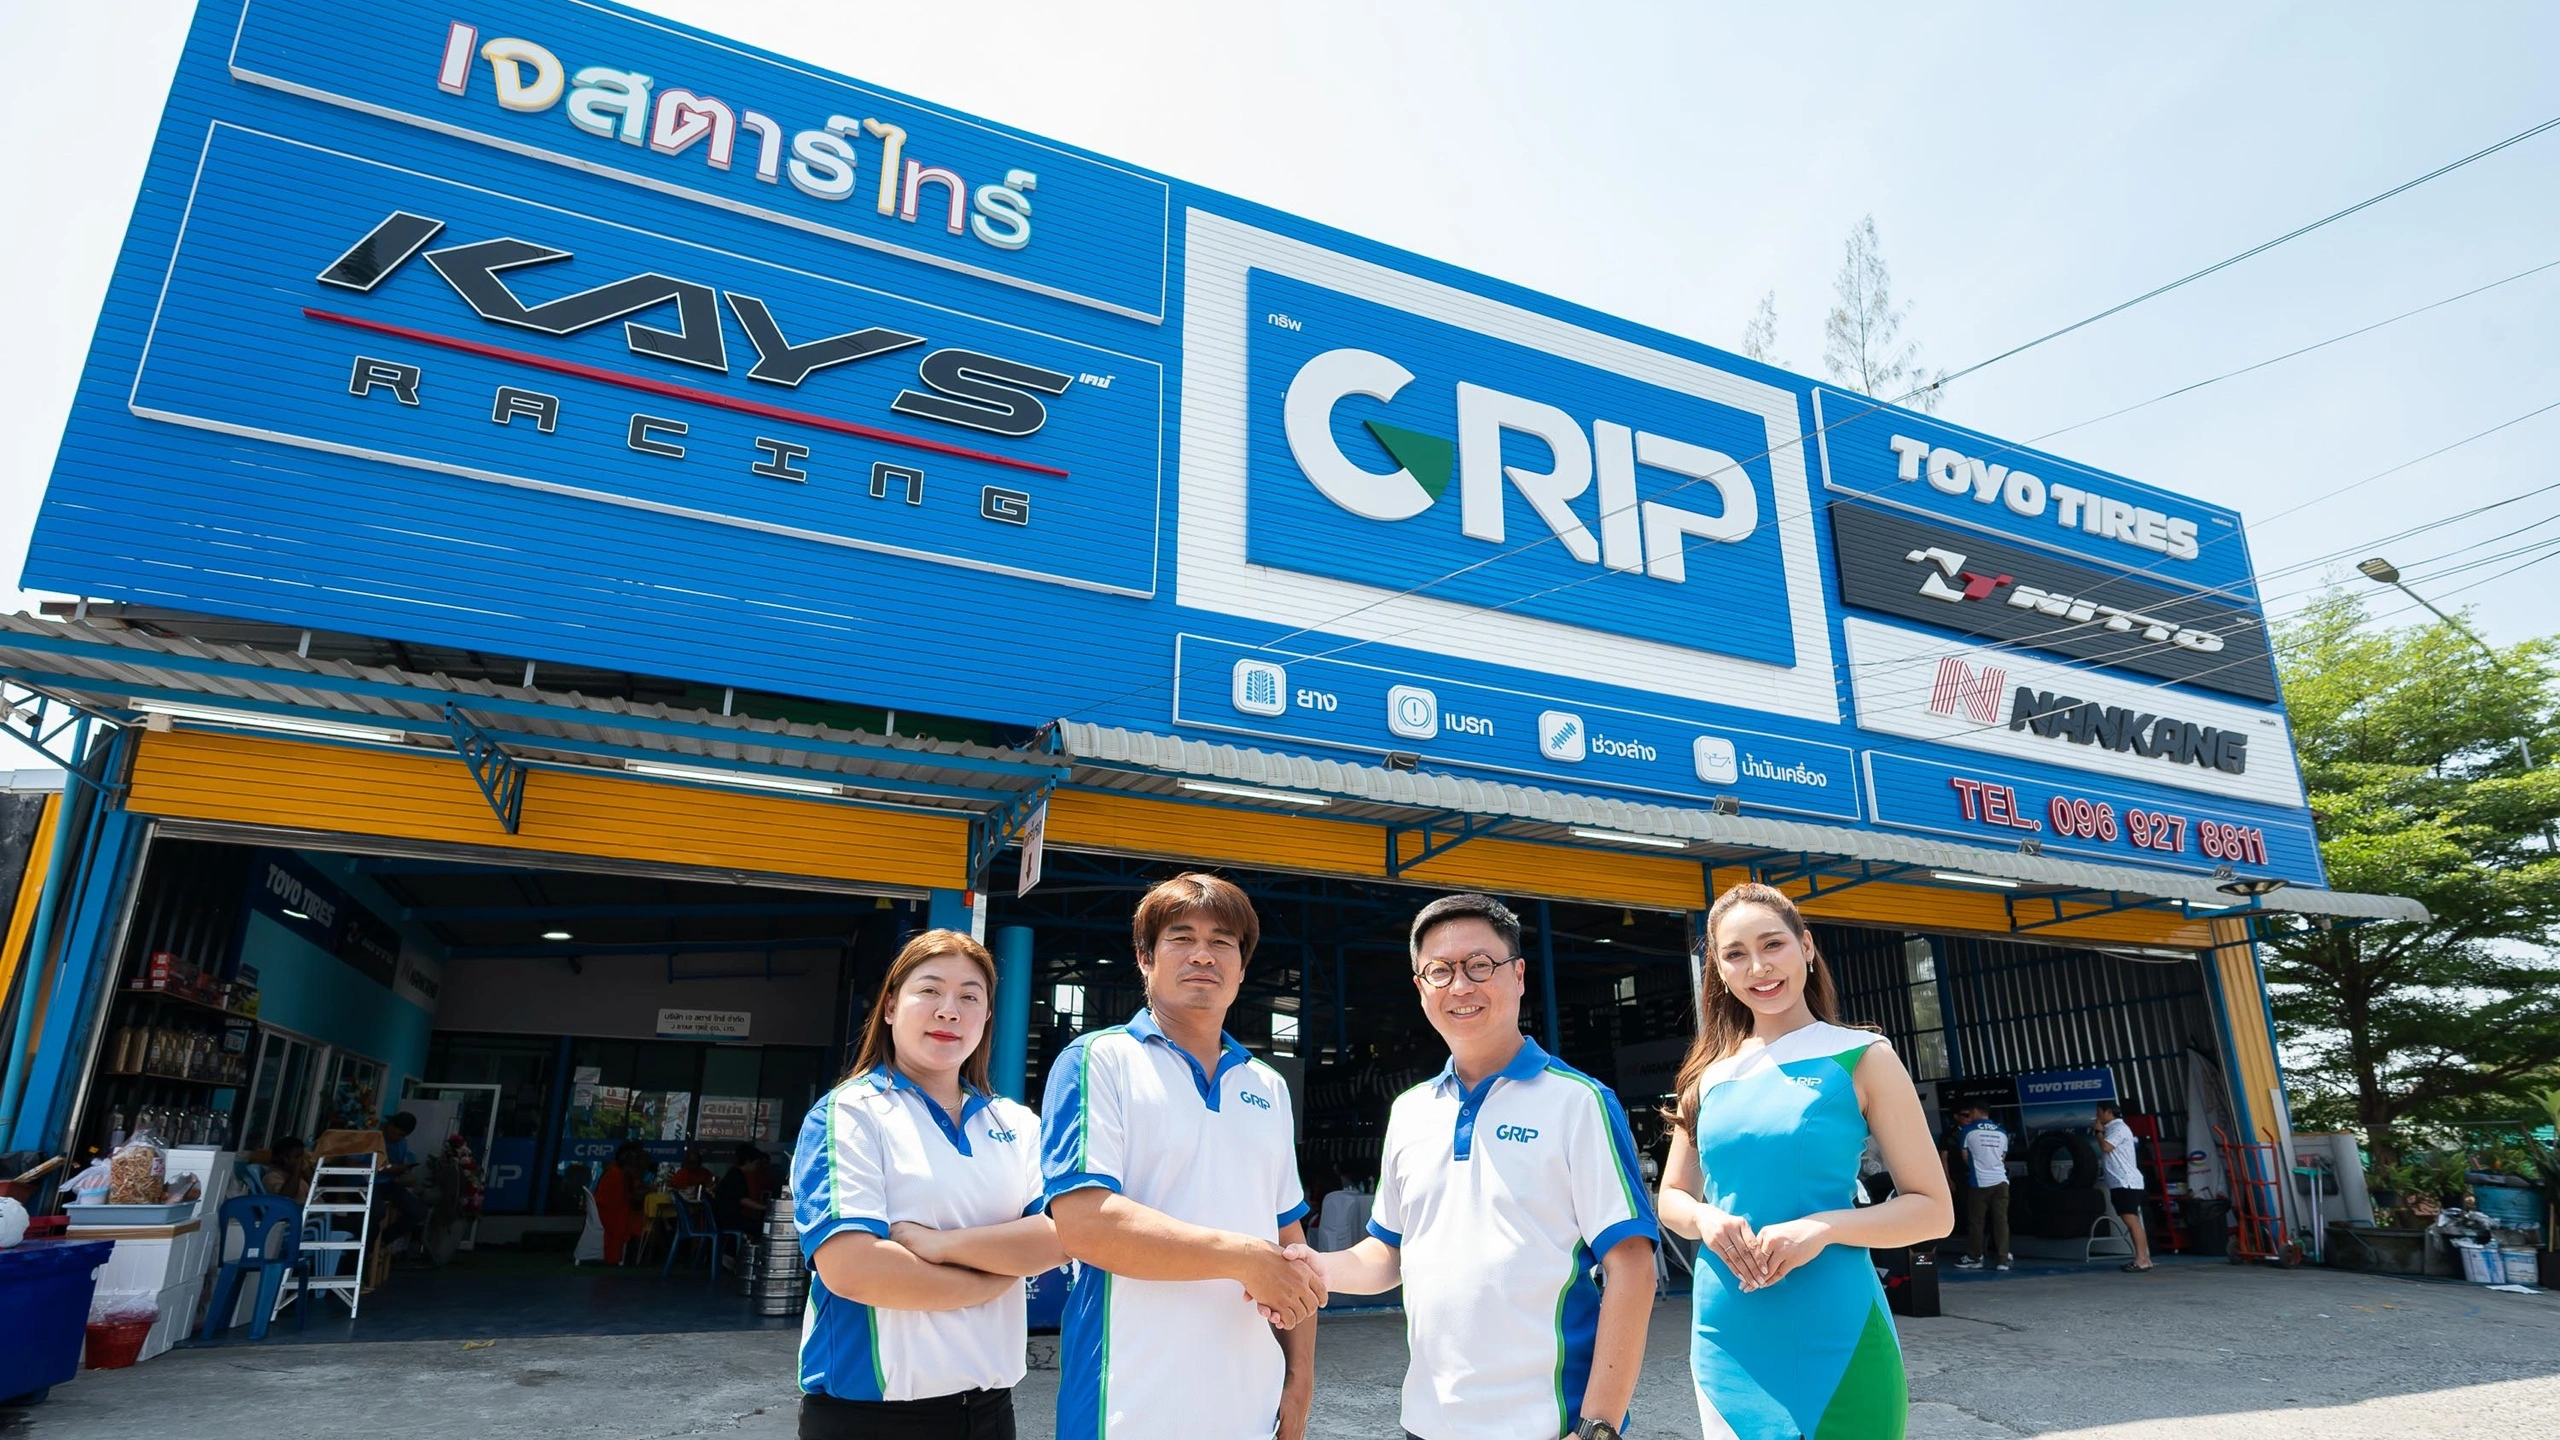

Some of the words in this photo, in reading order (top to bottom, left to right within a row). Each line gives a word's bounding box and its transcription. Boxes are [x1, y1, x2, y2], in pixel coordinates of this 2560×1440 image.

[437, 19, 1038, 250] เจสตาร์ไทร์
[315, 209, 1076, 438] KAYS
[1268, 313, 1303, 332] กริพ
[347, 354, 1030, 526] RACING
[1283, 347, 1759, 585] GRIP
[1890, 433, 2046, 517] TOYO
[2050, 482, 2199, 561] TIRES
[2007, 584, 2225, 653] NITTO
[1296, 689, 1338, 713] ยาง
[1444, 712, 1494, 737] เบรก
[2009, 686, 2248, 776] NANKANG
[1591, 734, 1657, 762] ช่วงล่าง
[1741, 752, 1828, 788] น้ำมันเครื่อง
[1950, 777, 2043, 833] TEL.
[2049, 795, 2118, 844] 096
[2126, 808, 2186, 853] 927
[2198, 820, 2269, 867] 8811
[265, 863, 303, 906] TOYO
[301, 887, 336, 928] TIRES
[1240, 1090, 1271, 1110] GRIP
[2028, 1081, 2061, 1093] TOYO
[2063, 1078, 2103, 1091] TIRES
[1496, 1124, 1539, 1143] GRIP
